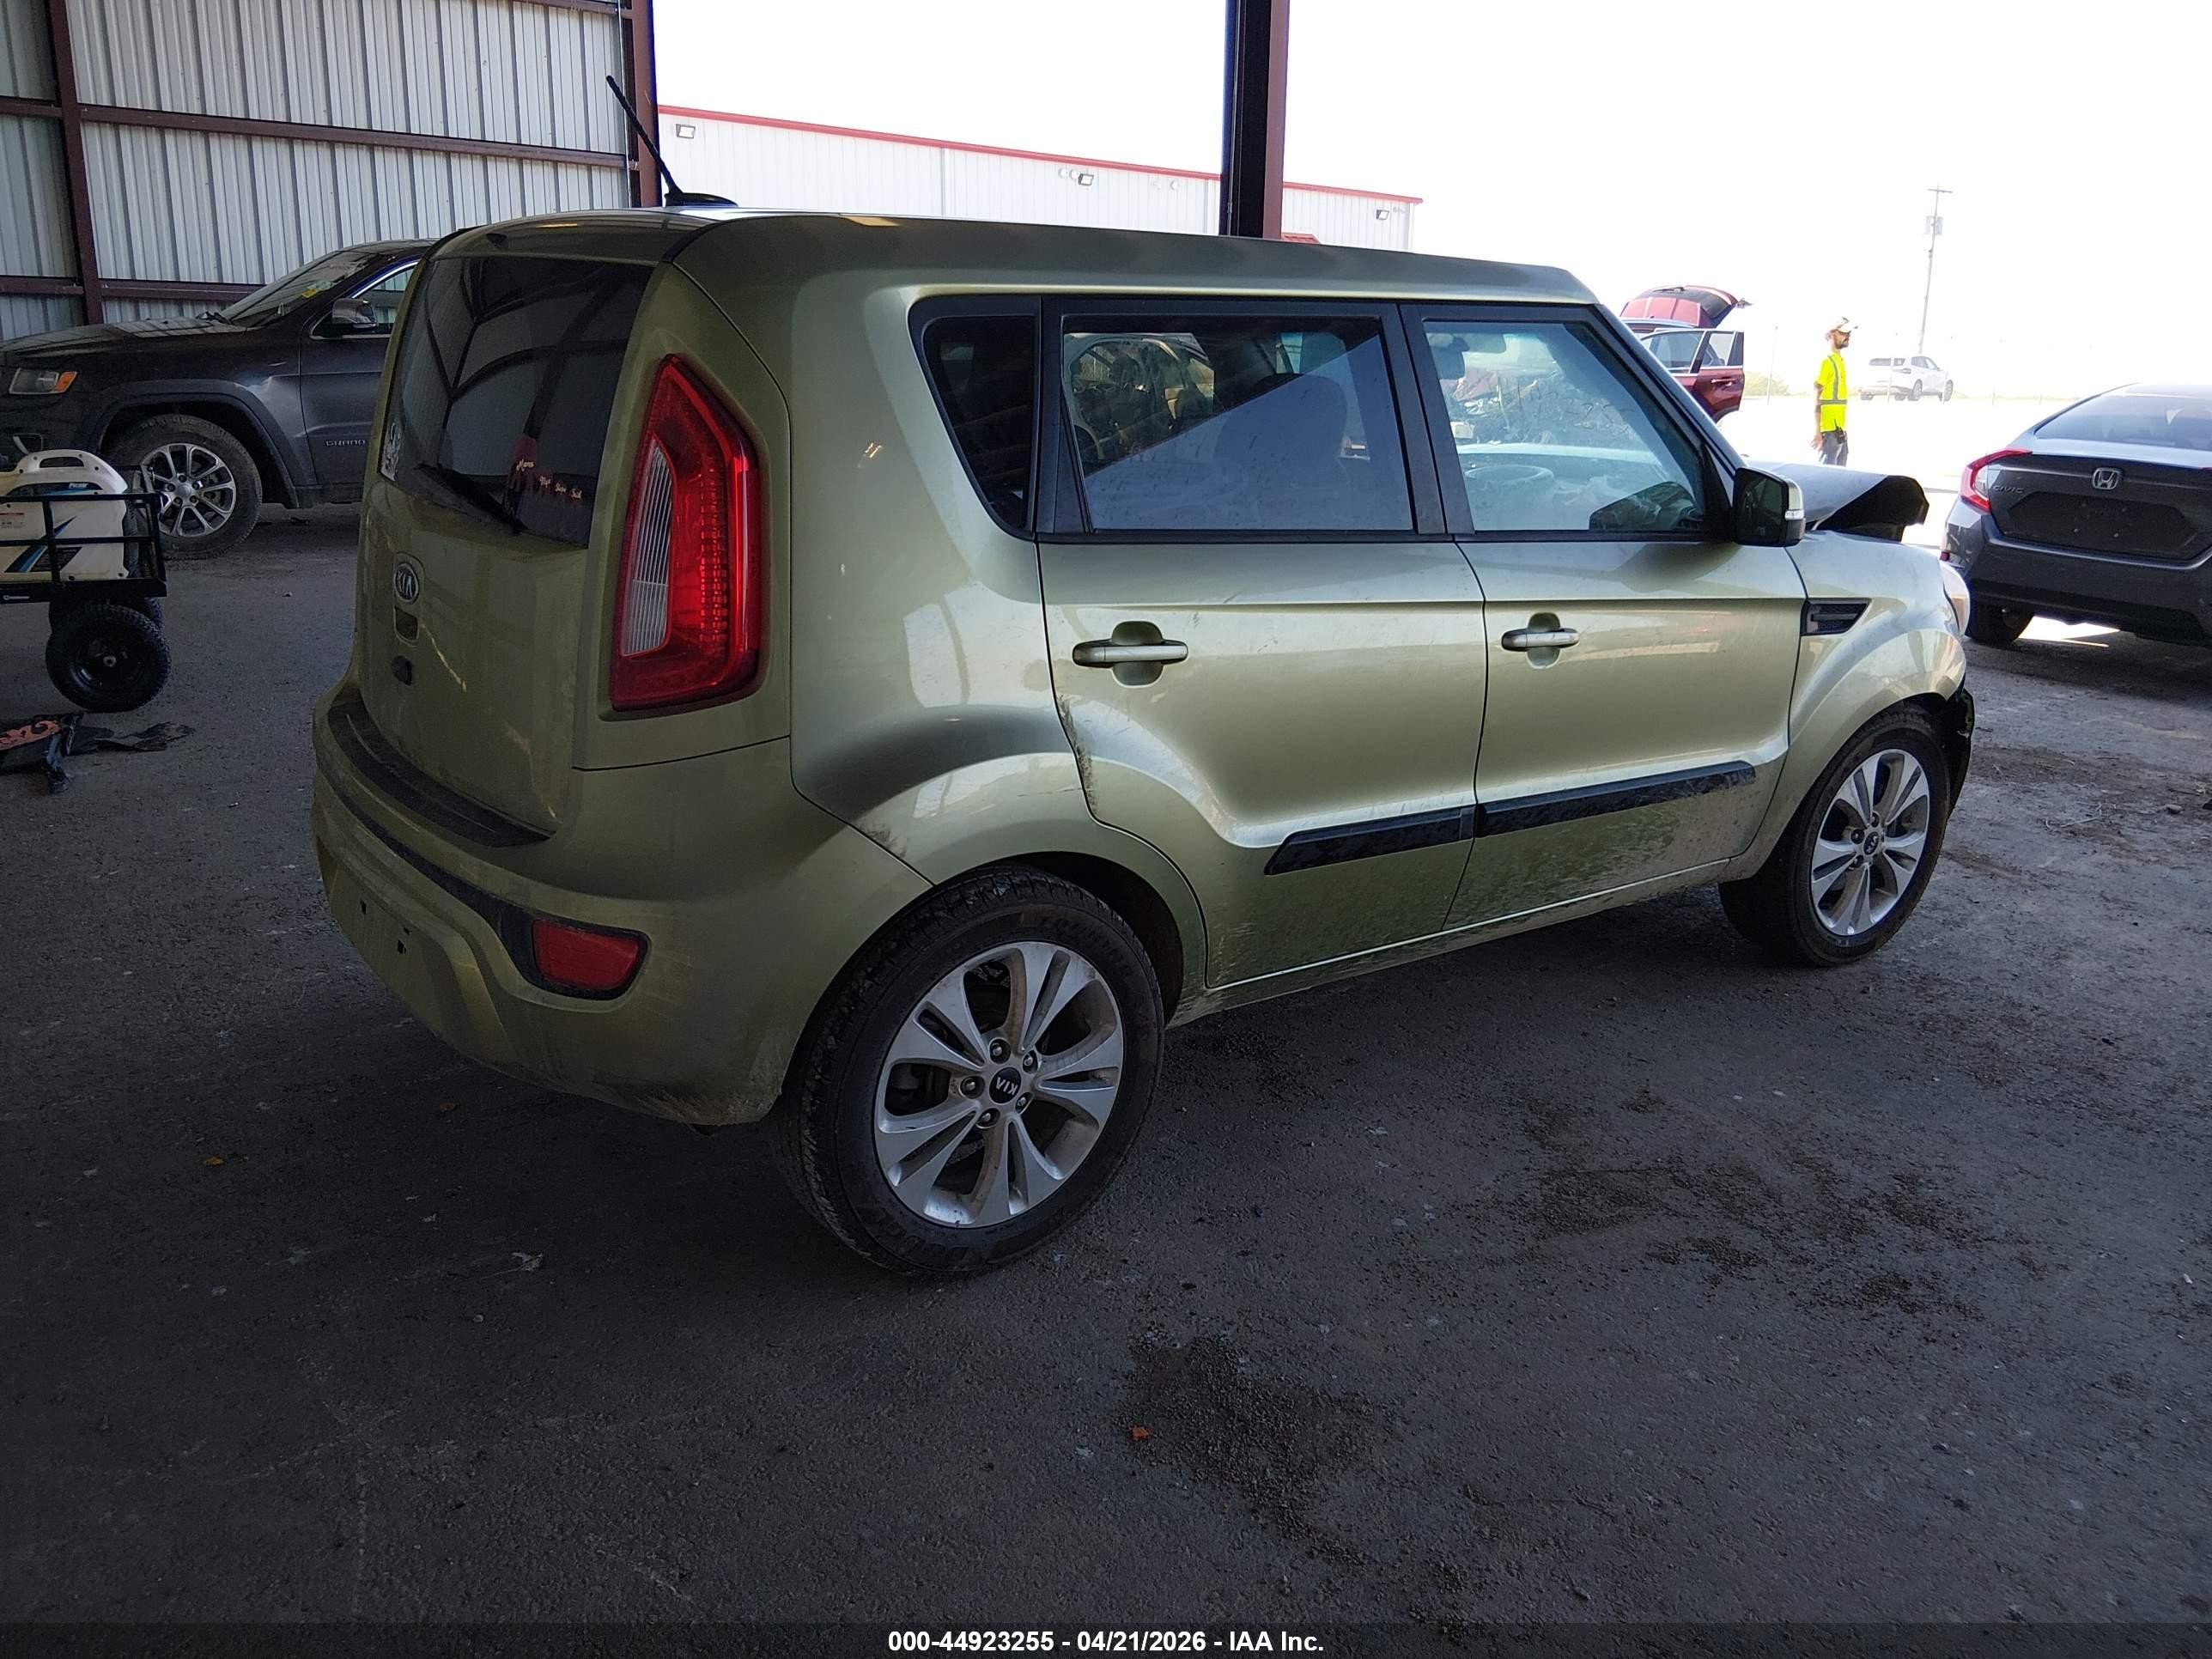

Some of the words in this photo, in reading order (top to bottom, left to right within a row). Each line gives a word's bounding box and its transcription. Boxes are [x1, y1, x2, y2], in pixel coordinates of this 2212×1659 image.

[1992, 484, 2025, 494] CIVIC
[397, 568, 413, 599] KIA
[995, 1076, 1019, 1097] KIA
